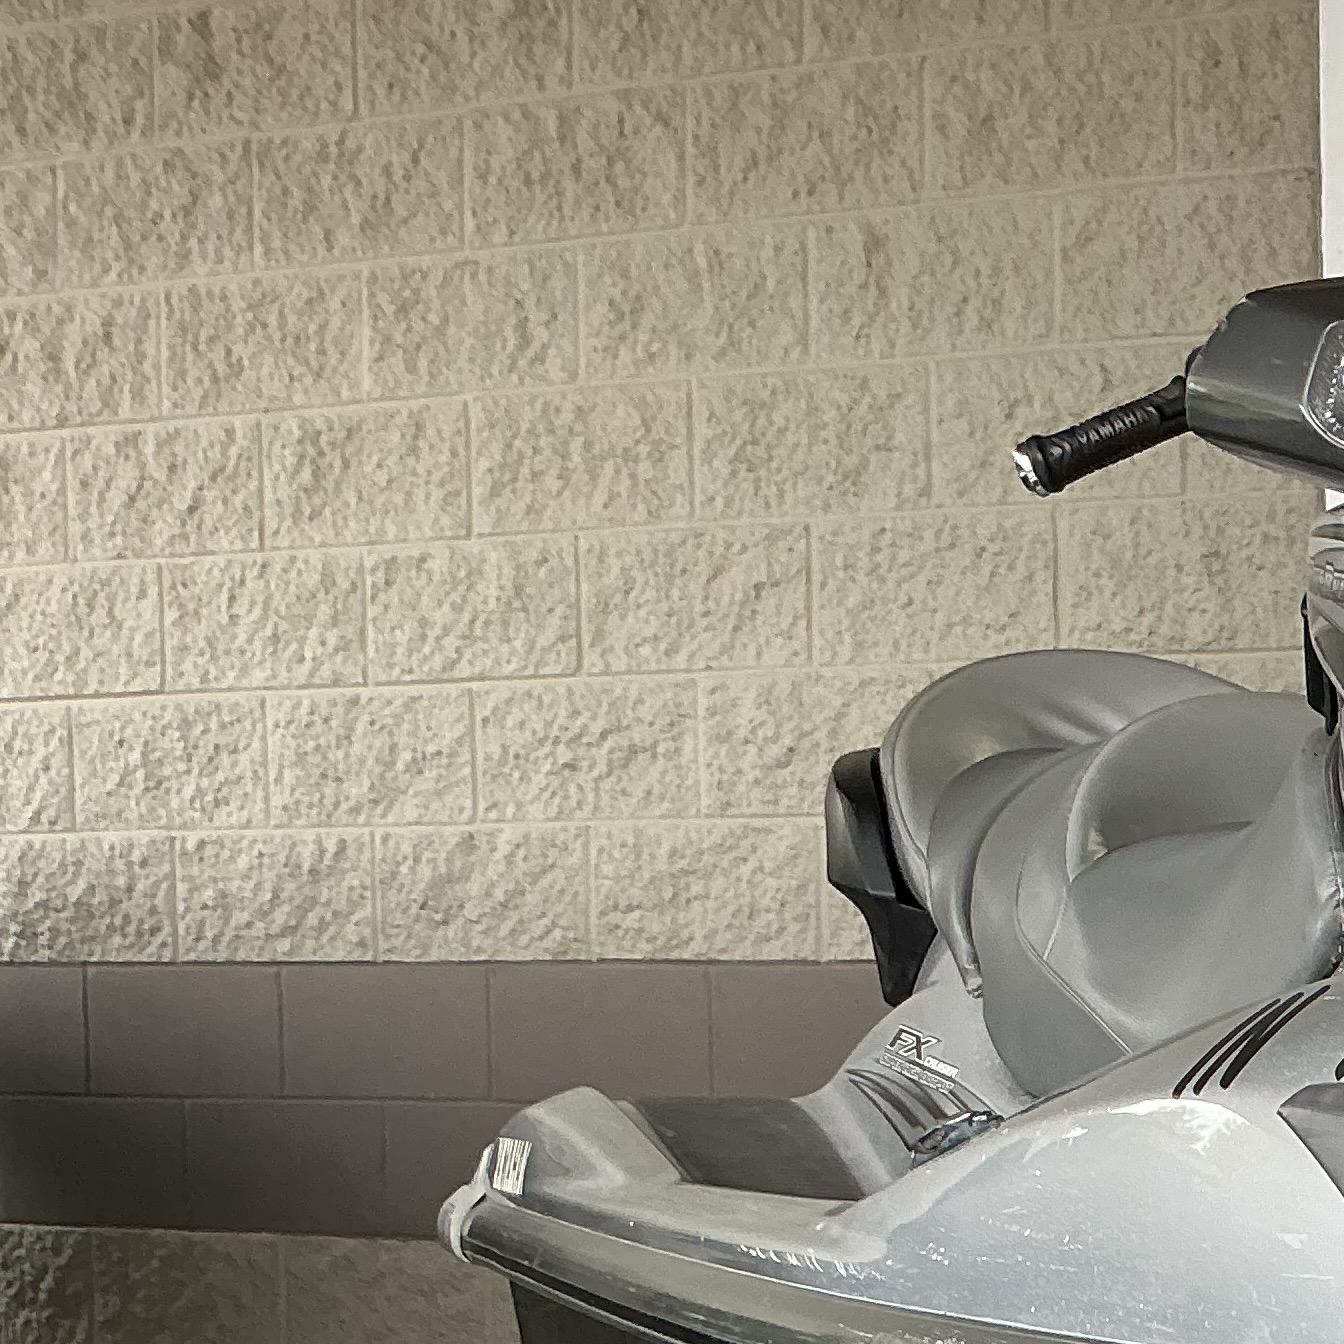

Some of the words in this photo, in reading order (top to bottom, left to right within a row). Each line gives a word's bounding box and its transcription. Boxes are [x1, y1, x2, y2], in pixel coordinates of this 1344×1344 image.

[1078, 406, 1160, 445] YAMAHA
[885, 1024, 942, 1063] FX
[1172, 985, 1331, 1099] IN
